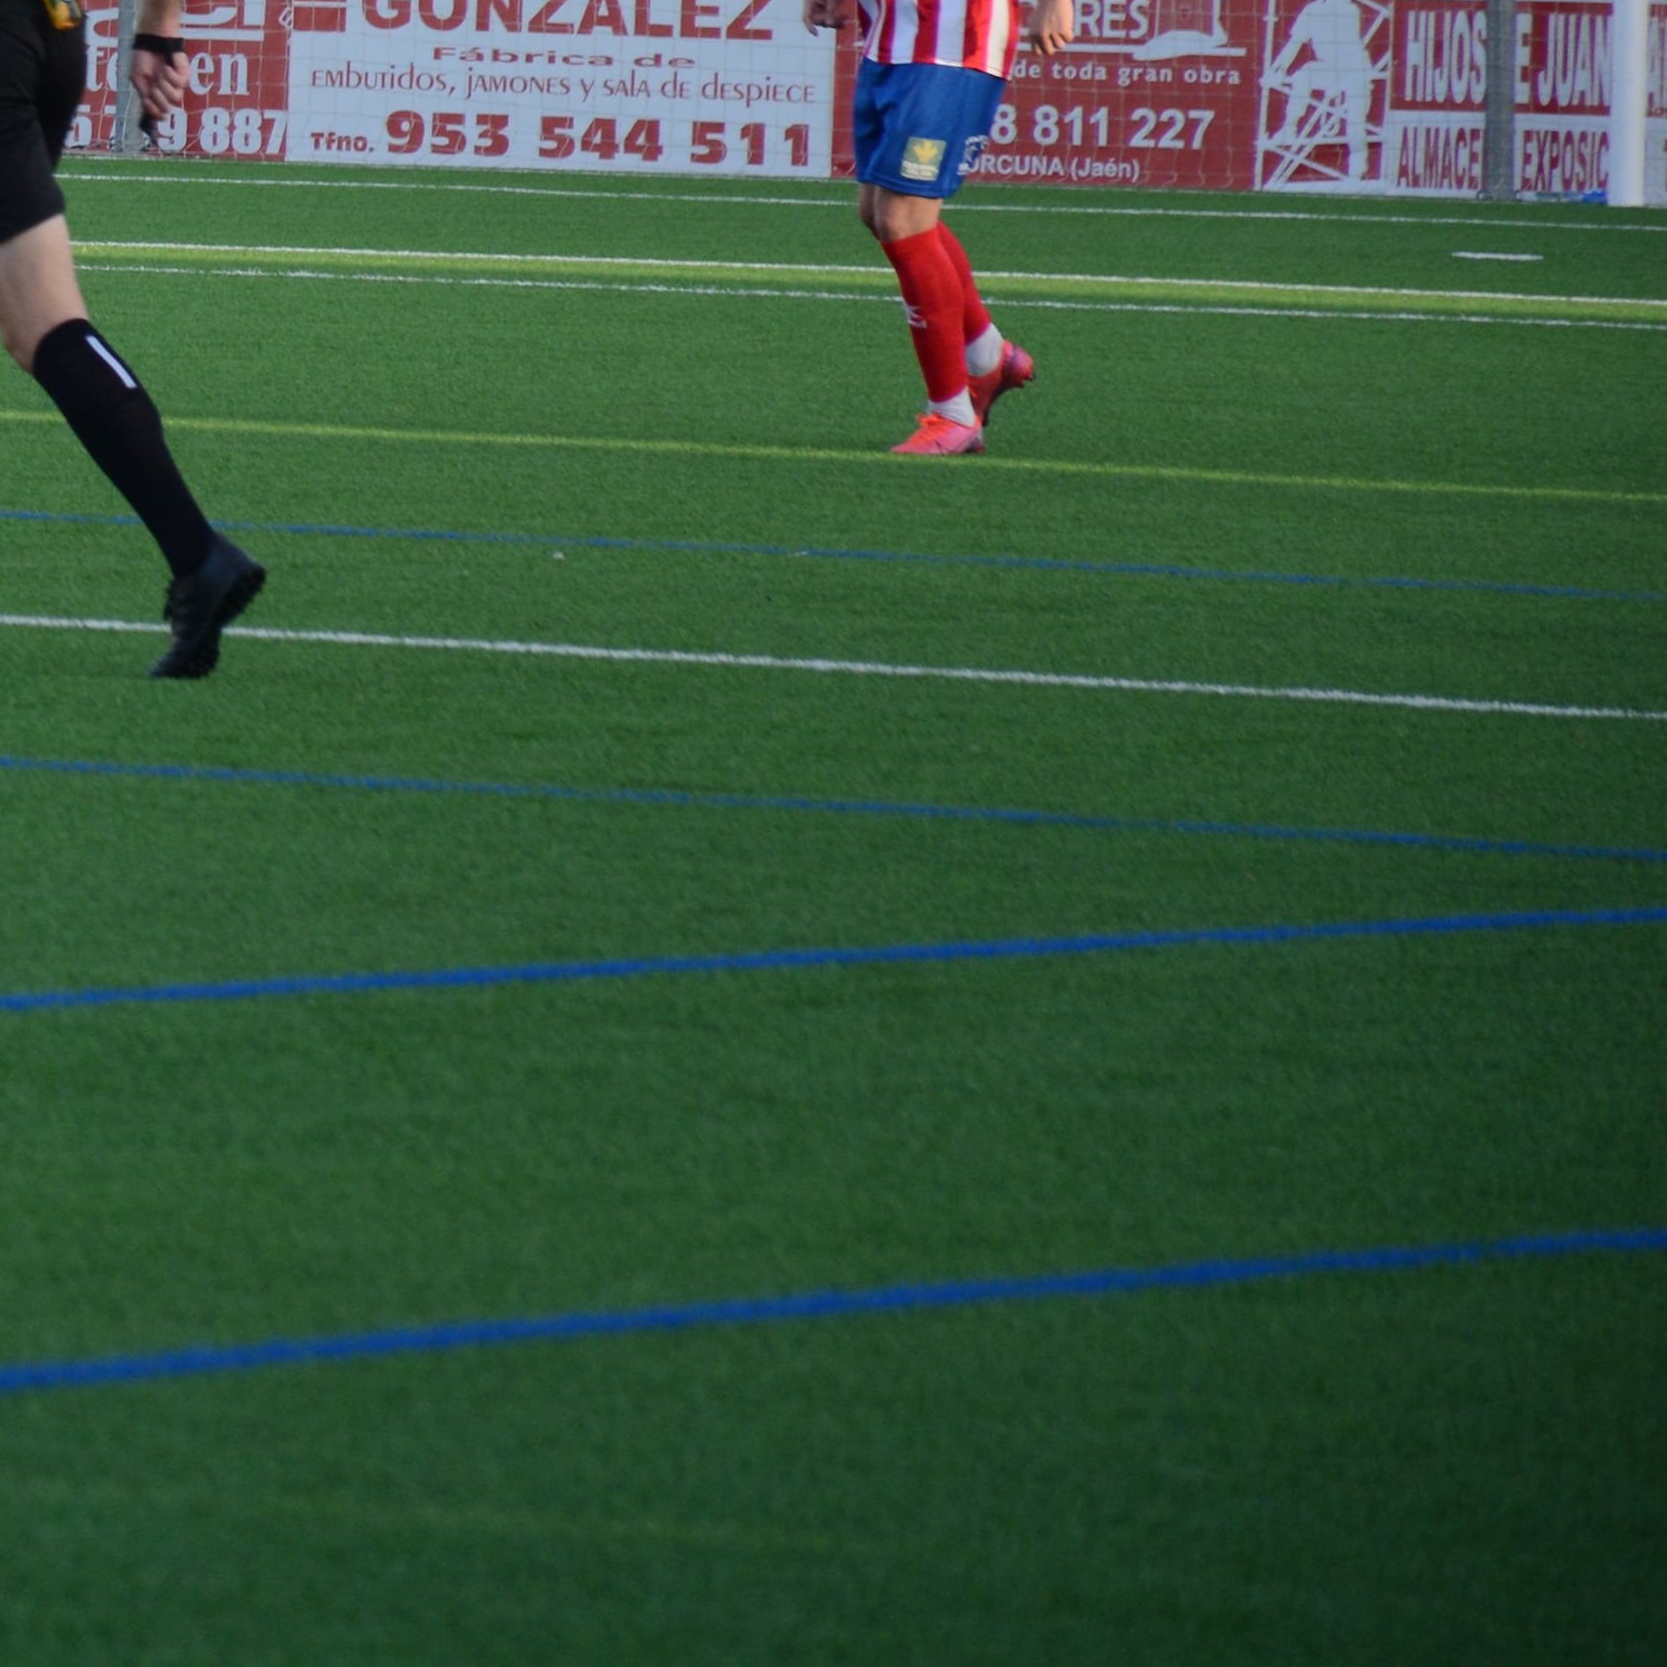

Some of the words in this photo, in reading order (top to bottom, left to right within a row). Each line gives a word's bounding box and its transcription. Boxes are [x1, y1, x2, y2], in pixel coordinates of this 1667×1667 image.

[433, 46, 613, 66] Fábrica
[634, 53, 696, 69] de
[1014, 61, 1042, 78] de
[1052, 62, 1107, 81] toda
[1118, 65, 1173, 86] gran
[1184, 66, 1242, 85] obra
[1403, 10, 1487, 104] HIJOS
[1538, 12, 1613, 108] JUAN
[579, 77, 595, 102] y
[311, 132, 374, 153] Tfno.
[386, 110, 509, 156] 953
[538, 115, 664, 162] 544
[690, 120, 810, 167] 511
[1033, 105, 1109, 146] 811
[1128, 107, 1216, 150] 227
[1070, 157, 1140, 182] (Jaén)
[1396, 126, 1483, 190] ALMACE
